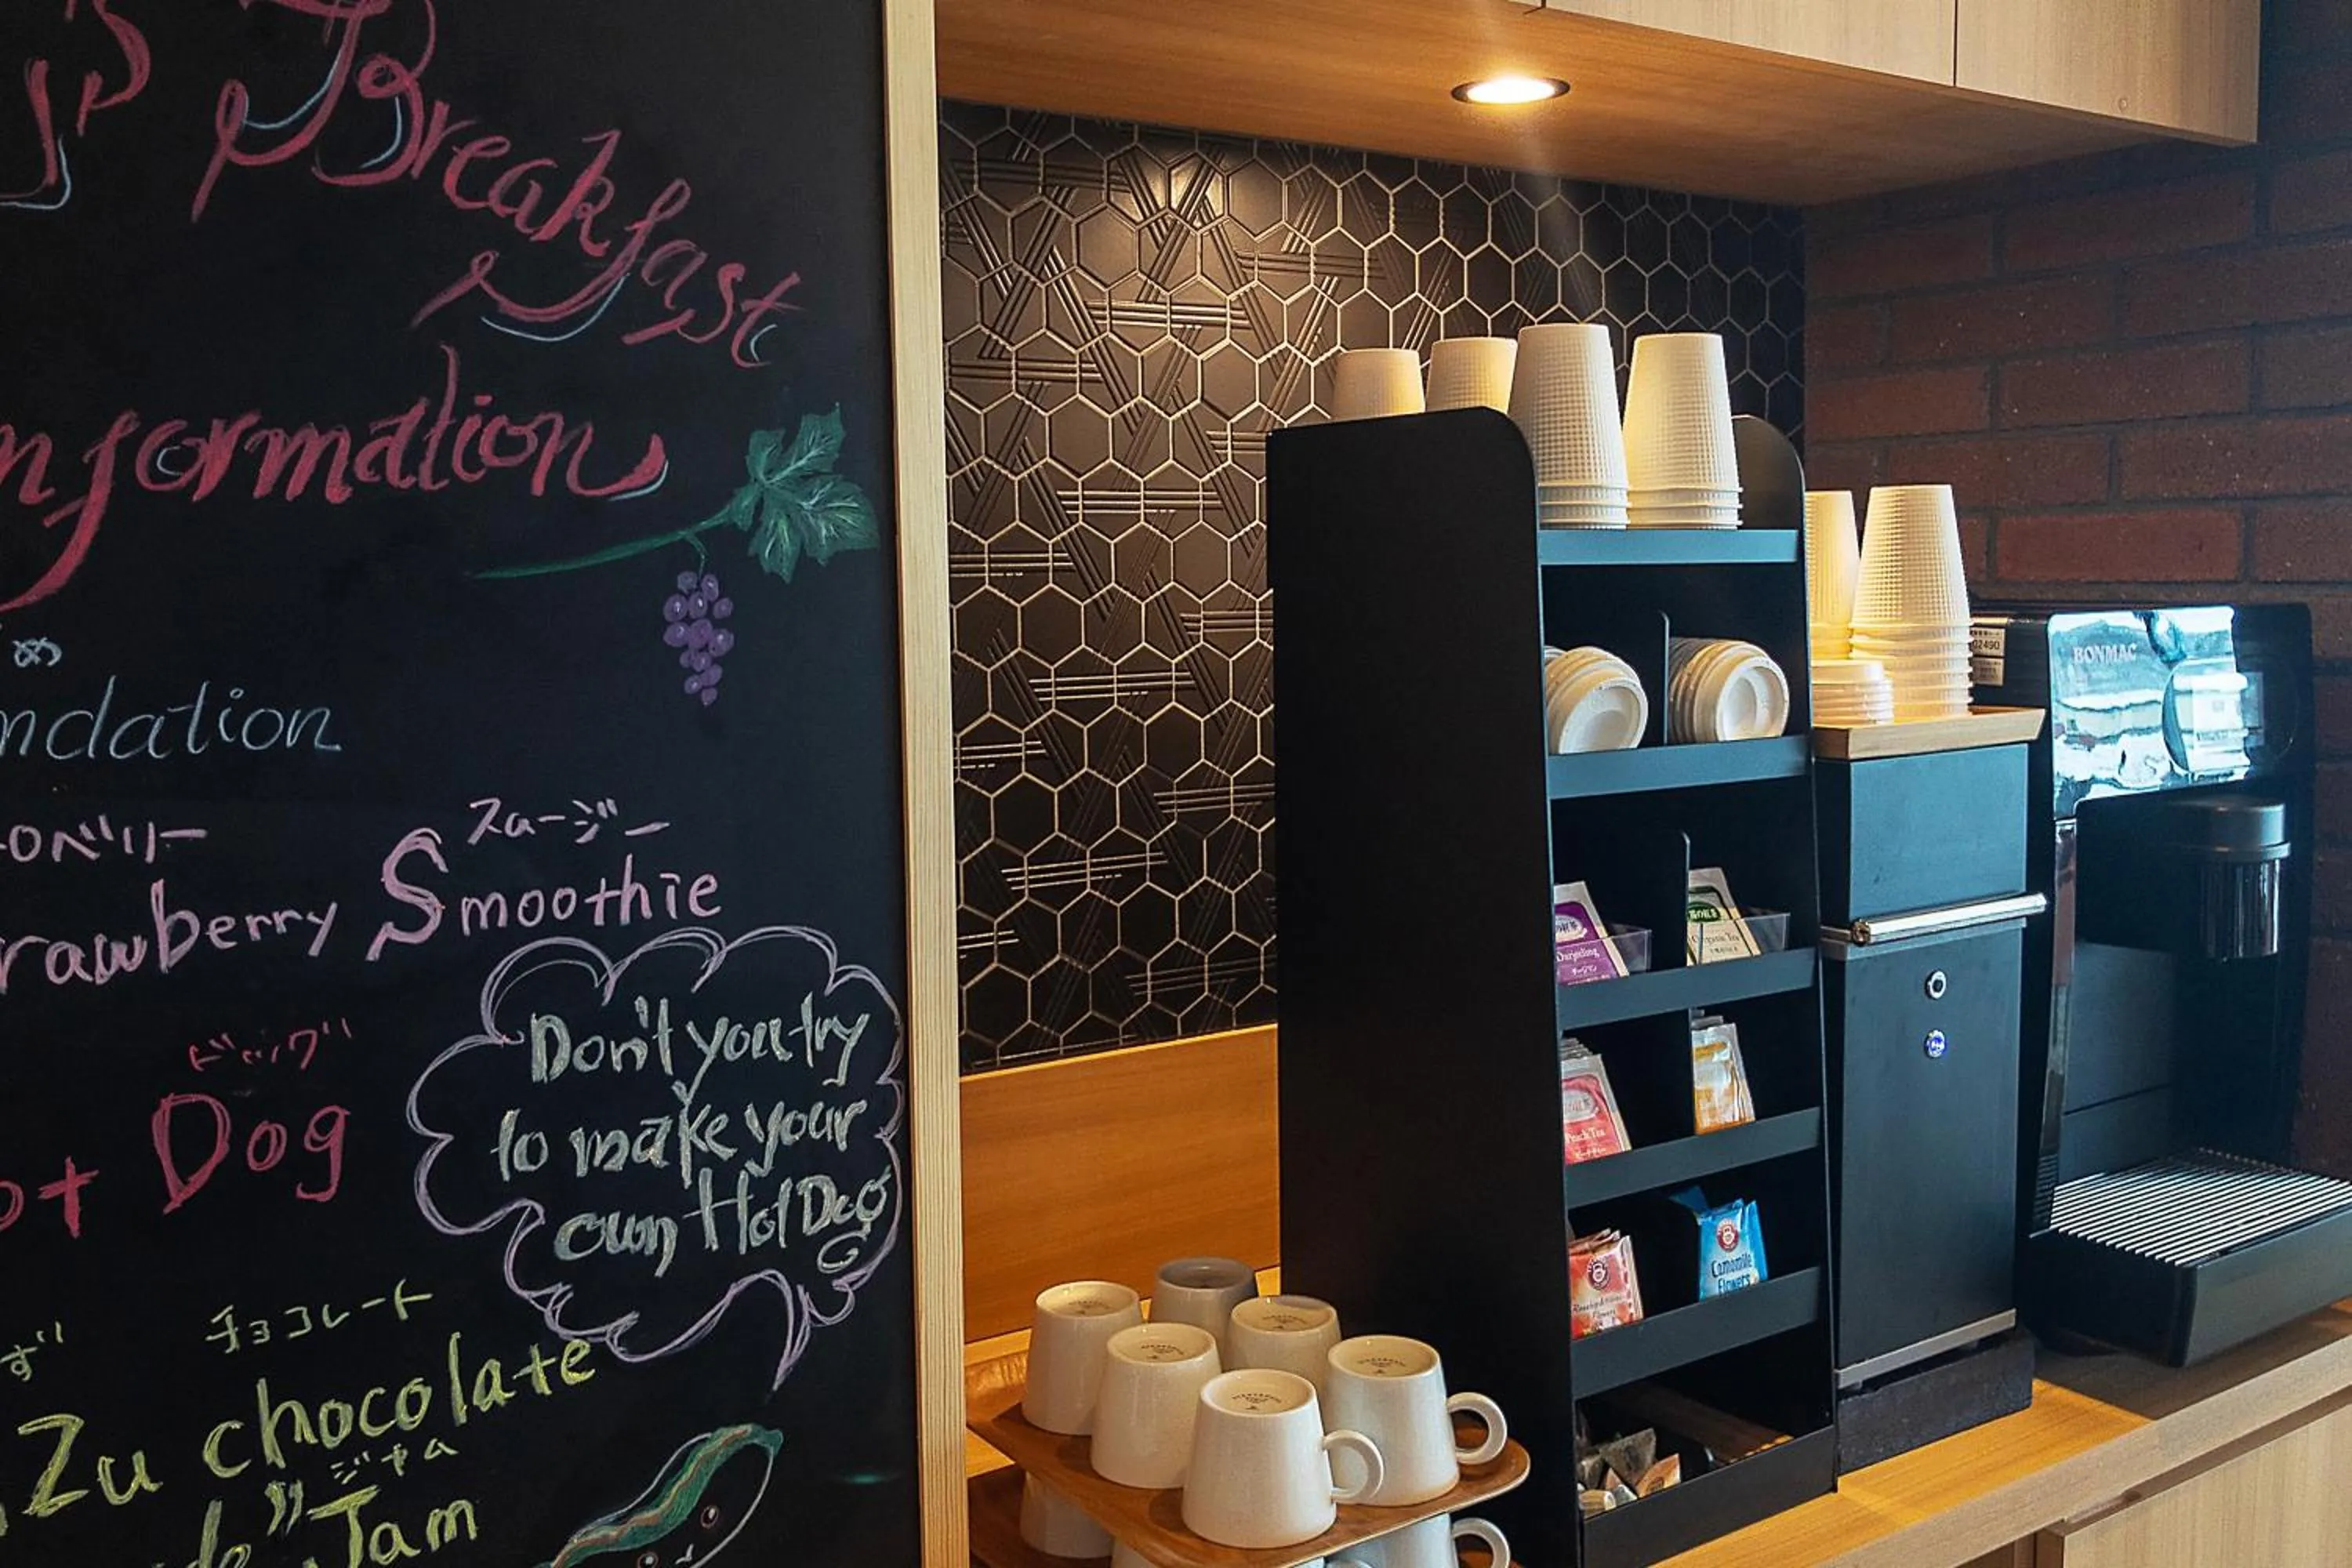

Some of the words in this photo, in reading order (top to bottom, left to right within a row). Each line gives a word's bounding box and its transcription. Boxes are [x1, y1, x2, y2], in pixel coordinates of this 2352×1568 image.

[2072, 644, 2137, 664] BONMAC
[365, 827, 723, 962] Smoothie
[151, 1093, 351, 1215] Dog
[490, 1108, 549, 1182] to
[570, 1093, 737, 1189] make
[745, 1100, 868, 1178] your
[203, 1331, 595, 1479] chocolate
